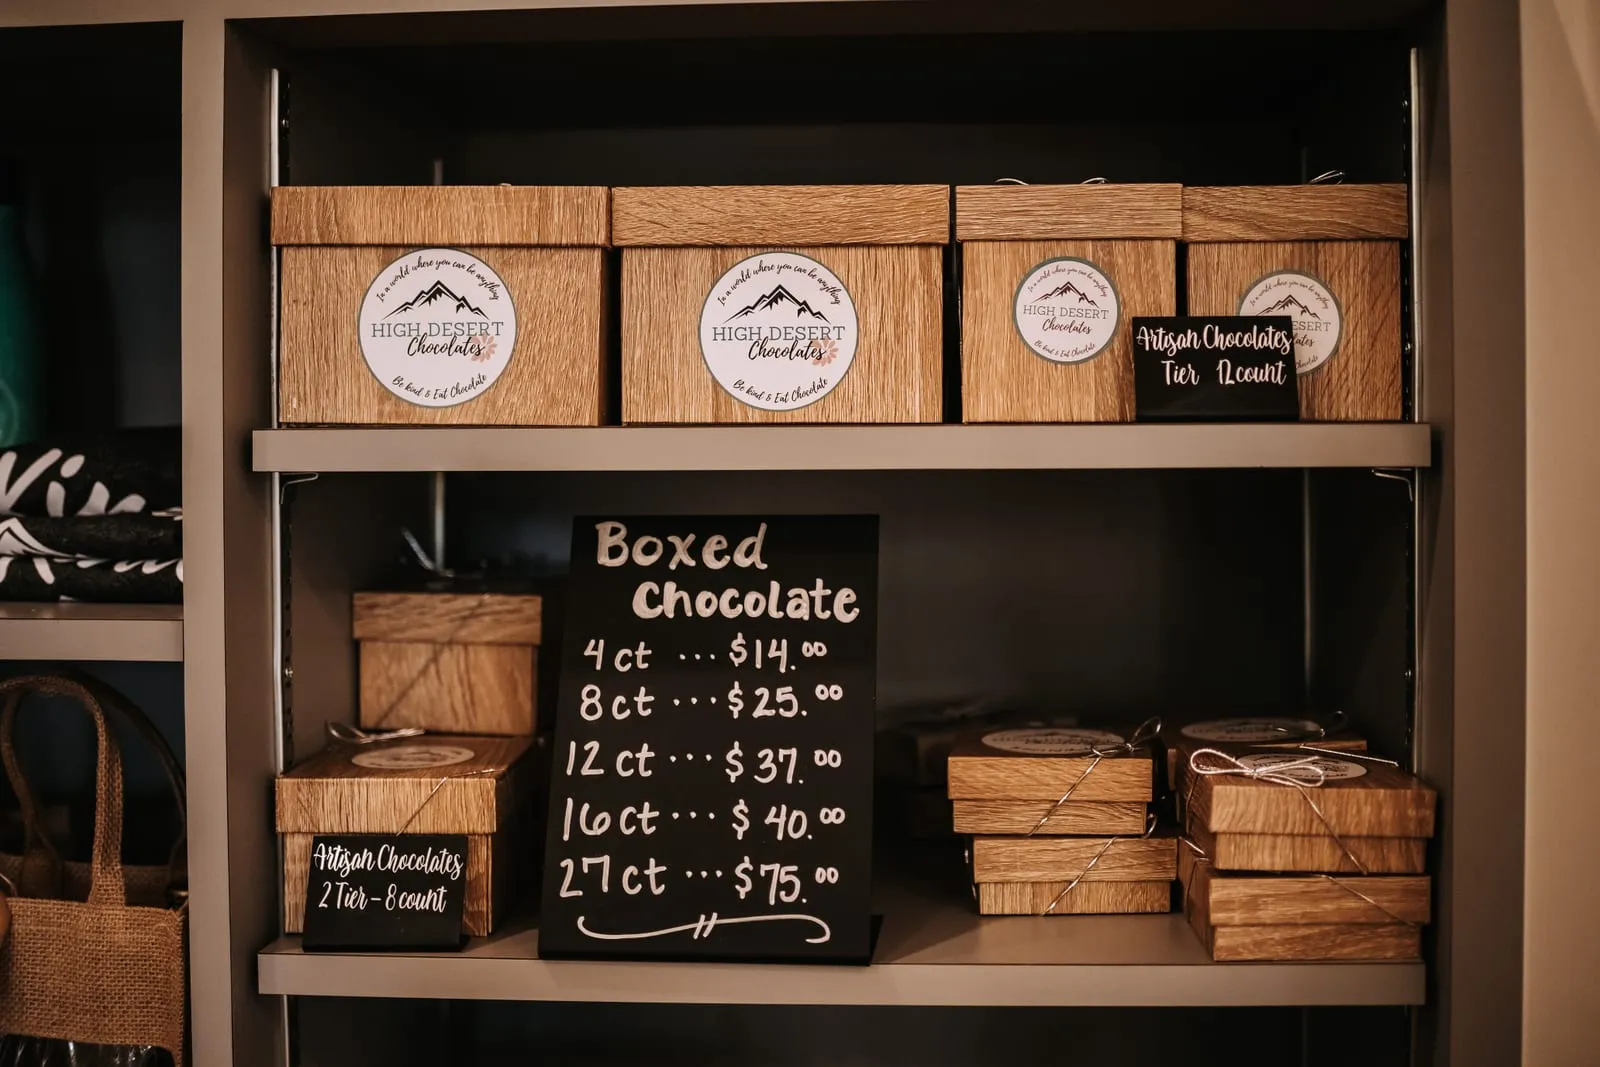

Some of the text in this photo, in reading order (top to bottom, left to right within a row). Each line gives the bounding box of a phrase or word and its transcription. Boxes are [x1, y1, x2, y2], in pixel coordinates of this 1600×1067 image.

[376, 293, 386, 303] In
[391, 265, 410, 288] world
[412, 256, 434, 271] where
[436, 260, 451, 270] you
[453, 261, 466, 270] can
[466, 264, 476, 275] be
[476, 274, 501, 300] anything
[718, 297, 727, 307] In
[732, 269, 751, 291] world
[753, 260, 775, 276] where
[776, 264, 792, 275] you
[794, 265, 807, 274] can
[808, 268, 817, 280] be
[817, 278, 842, 305] anything
[1023, 305, 1110, 320] HIGH DESERT
[1042, 317, 1092, 335] Chocolates
[1292, 321, 1332, 332] ESERT
[371, 322, 504, 338] HIGH DESERT
[407, 333, 486, 357] Chocolates
[713, 326, 845, 341] HIGH DESERT
[1136, 324, 1293, 357] Artisan Chocolates
[748, 336, 827, 361] Chocolates
[392, 376, 404, 388] Be
[405, 382, 425, 397] kind
[433, 388, 448, 400] Eat
[451, 373, 487, 398] Chocolate
[1161, 360, 1200, 385] Tier
[733, 379, 745, 392] Be
[746, 386, 764, 401] kind
[775, 393, 789, 404] Eat
[792, 377, 828, 402] Chocolate
[595, 521, 769, 571] Boxed
[632, 578, 860, 624] Chocolate
[584, 639, 605, 671] 4
[614, 641, 653, 673] ct
[580, 684, 603, 721] 8
[612, 686, 655, 721] ct
[566, 741, 605, 776] 12
[615, 743, 655, 777] ct
[563, 798, 612, 841] 16
[620, 802, 660, 835] ct
[314, 843, 463, 880] Artisan Chocolates
[560, 855, 611, 898] 27
[622, 858, 667, 896] ct
[319, 881, 332, 908] 2
[336, 882, 368, 910] Tier
[385, 884, 397, 911] 8
[399, 886, 448, 913] count
